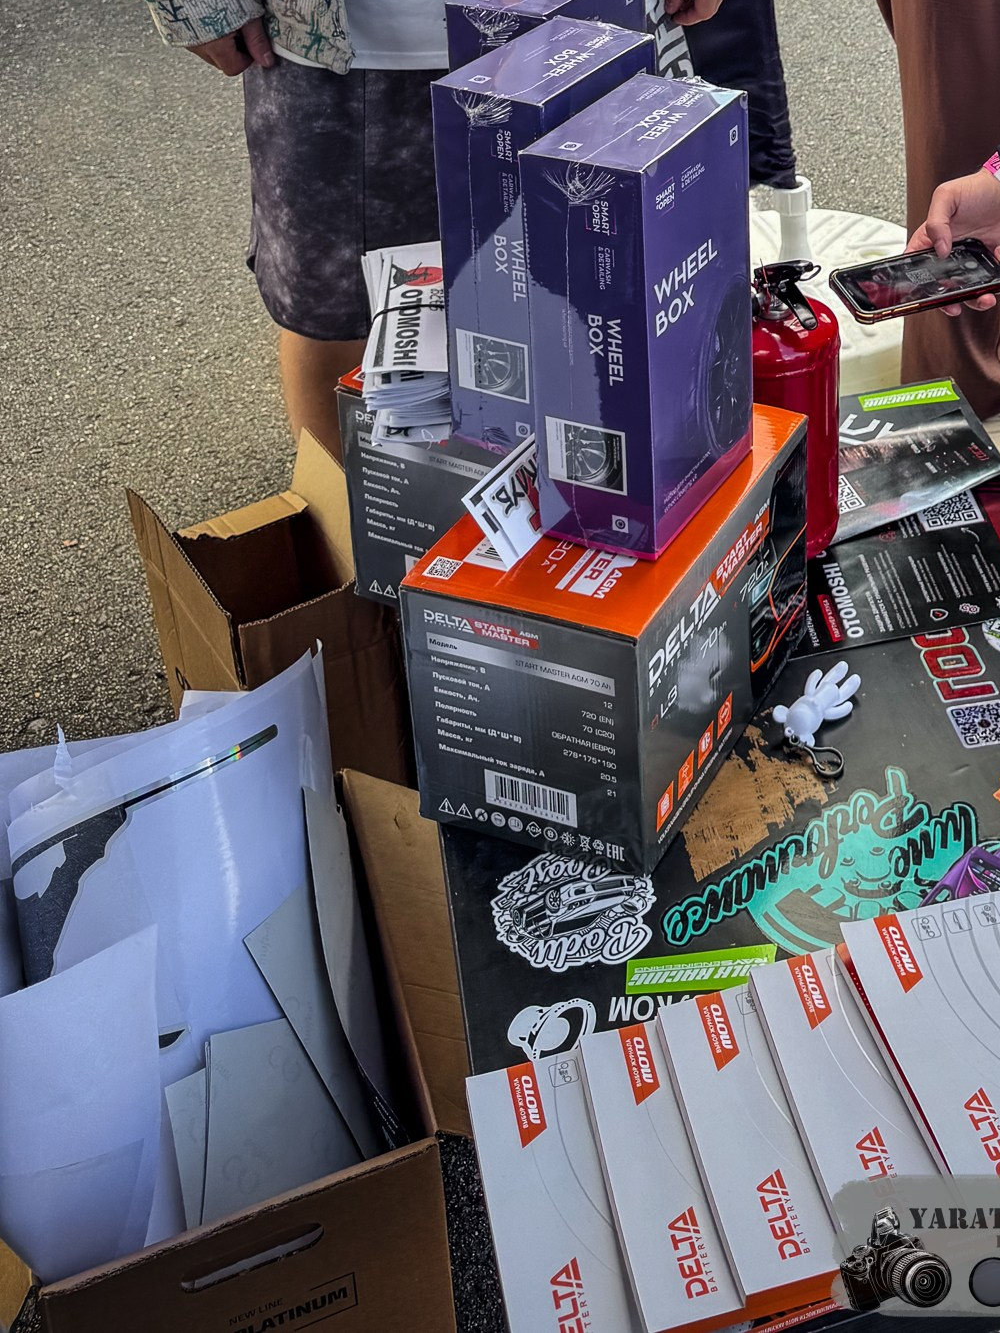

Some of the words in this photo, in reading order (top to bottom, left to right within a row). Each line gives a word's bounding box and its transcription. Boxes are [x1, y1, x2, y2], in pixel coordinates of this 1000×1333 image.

[543, 52, 595, 78] WHEEL
[544, 49, 578, 65] BOX
[637, 112, 687, 142] WHEEL
[639, 109, 669, 128] BOX
[505, 130, 513, 163] SMART
[655, 182, 676, 204] SMART
[600, 200, 610, 236] SMART
[494, 234, 509, 274] BOX
[511, 239, 527, 302] WHEEL
[654, 238, 718, 305] WHEEL
[655, 283, 695, 338] BOX
[393, 289, 423, 367] OTOMOSHI
[588, 314, 604, 357] BOX
[607, 318, 625, 387] WHEEL
[716, 529, 749, 580] START
[721, 521, 763, 585] MASTER
[594, 569, 623, 599] AGM
[739, 562, 764, 603] 720
[823, 562, 864, 639] OTOMOSHI
[424, 609, 475, 634] DELTA
[474, 621, 511, 634] START
[429, 638, 458, 650] Модель
[481, 630, 530, 647] MASTER
[649, 581, 723, 690] DELTA
[701, 626, 718, 659] 70
[432, 671, 466, 686] Пусковой
[468, 680, 482, 690] ток,
[539, 666, 570, 680] MASTER
[435, 700, 477, 717] Полярность
[603, 701, 613, 709] 12
[661, 684, 679, 718] L3
[436, 715, 473, 731] Габариты,
[581, 710, 597, 720] 720
[599, 715, 614, 726] (EN)
[582, 724, 593, 734] 70
[437, 728, 464, 742] Масса,
[551, 731, 591, 749] ОБРАТНАЯ
[591, 742, 616, 756] (ЕВРО)
[438, 743, 495, 764] Максимальный
[495, 758, 508, 767] ток
[600, 772, 617, 784] 20.5
[607, 789, 617, 798] 21
[881, 927, 898, 954] ЖУРНАЛА
[889, 925, 917, 974] МОТО
[628, 968, 714, 986] RACING
[891, 953, 907, 977] ВЫБОР
[793, 966, 808, 993] ЖУРНАЛА
[801, 964, 826, 1009] МОТО
[802, 993, 815, 1014] ВЫБОР
[702, 1006, 715, 1033] ЖУРНАЛА
[710, 1003, 733, 1050] МОТО
[625, 1039, 637, 1067] ЖУРНАЛА
[711, 1032, 722, 1054] ВЫБОР
[633, 1036, 654, 1084] МОТО
[632, 1066, 642, 1088] ВЫБОР
[513, 1078, 524, 1107] ЖУРНАЛА
[521, 1075, 541, 1124] МОТО
[520, 1107, 529, 1129] ВЫБОР
[755, 1168, 803, 1261] DELTA
[784, 1198, 812, 1254] BATTERY
[667, 1205, 711, 1300] DELTA
[694, 1236, 720, 1294] BATTERY
[229, 1311, 256, 1327] NEW
[258, 1298, 284, 1314] LINE
